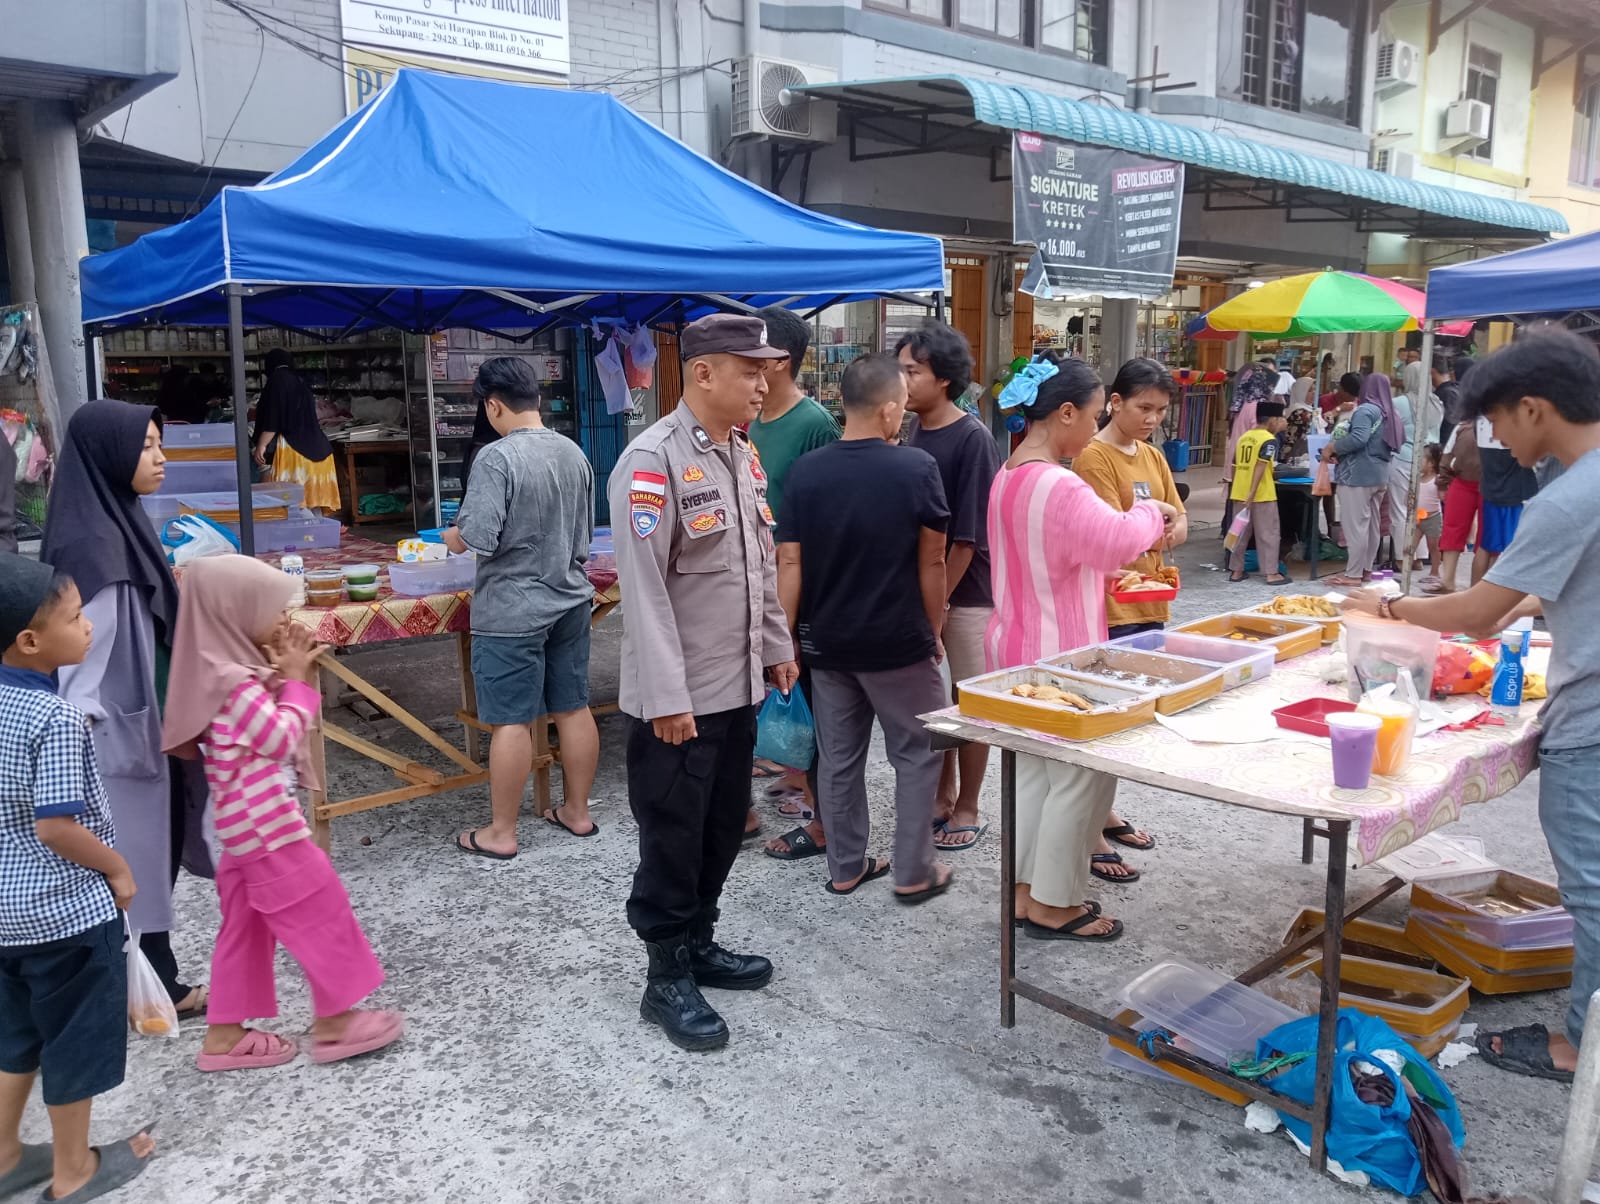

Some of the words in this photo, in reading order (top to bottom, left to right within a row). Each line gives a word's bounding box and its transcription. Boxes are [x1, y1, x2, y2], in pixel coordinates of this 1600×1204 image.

[492, 0, 561, 21] ernation
[375, 10, 403, 24] Komp
[406, 15, 430, 27] Pasar
[433, 20, 447, 30] Sei
[449, 23, 487, 37] Harapan
[489, 29, 508, 41] Blok
[510, 33, 518, 42] D
[535, 38, 544, 47] 01
[378, 24, 425, 40] Sekupang
[485, 42, 504, 53] 0811
[1030, 175, 1099, 202] SIGNATURE
[1117, 171, 1149, 190] REVOLUSI
[1149, 168, 1176, 185] KRETEK
[1042, 200, 1085, 218] KRETEK
[1047, 238, 1076, 257] 16.000
[1240, 444, 1253, 463] 10
[681, 488, 722, 510] SYEFRIADI
[1507, 662, 1518, 700] ISOPLUS
